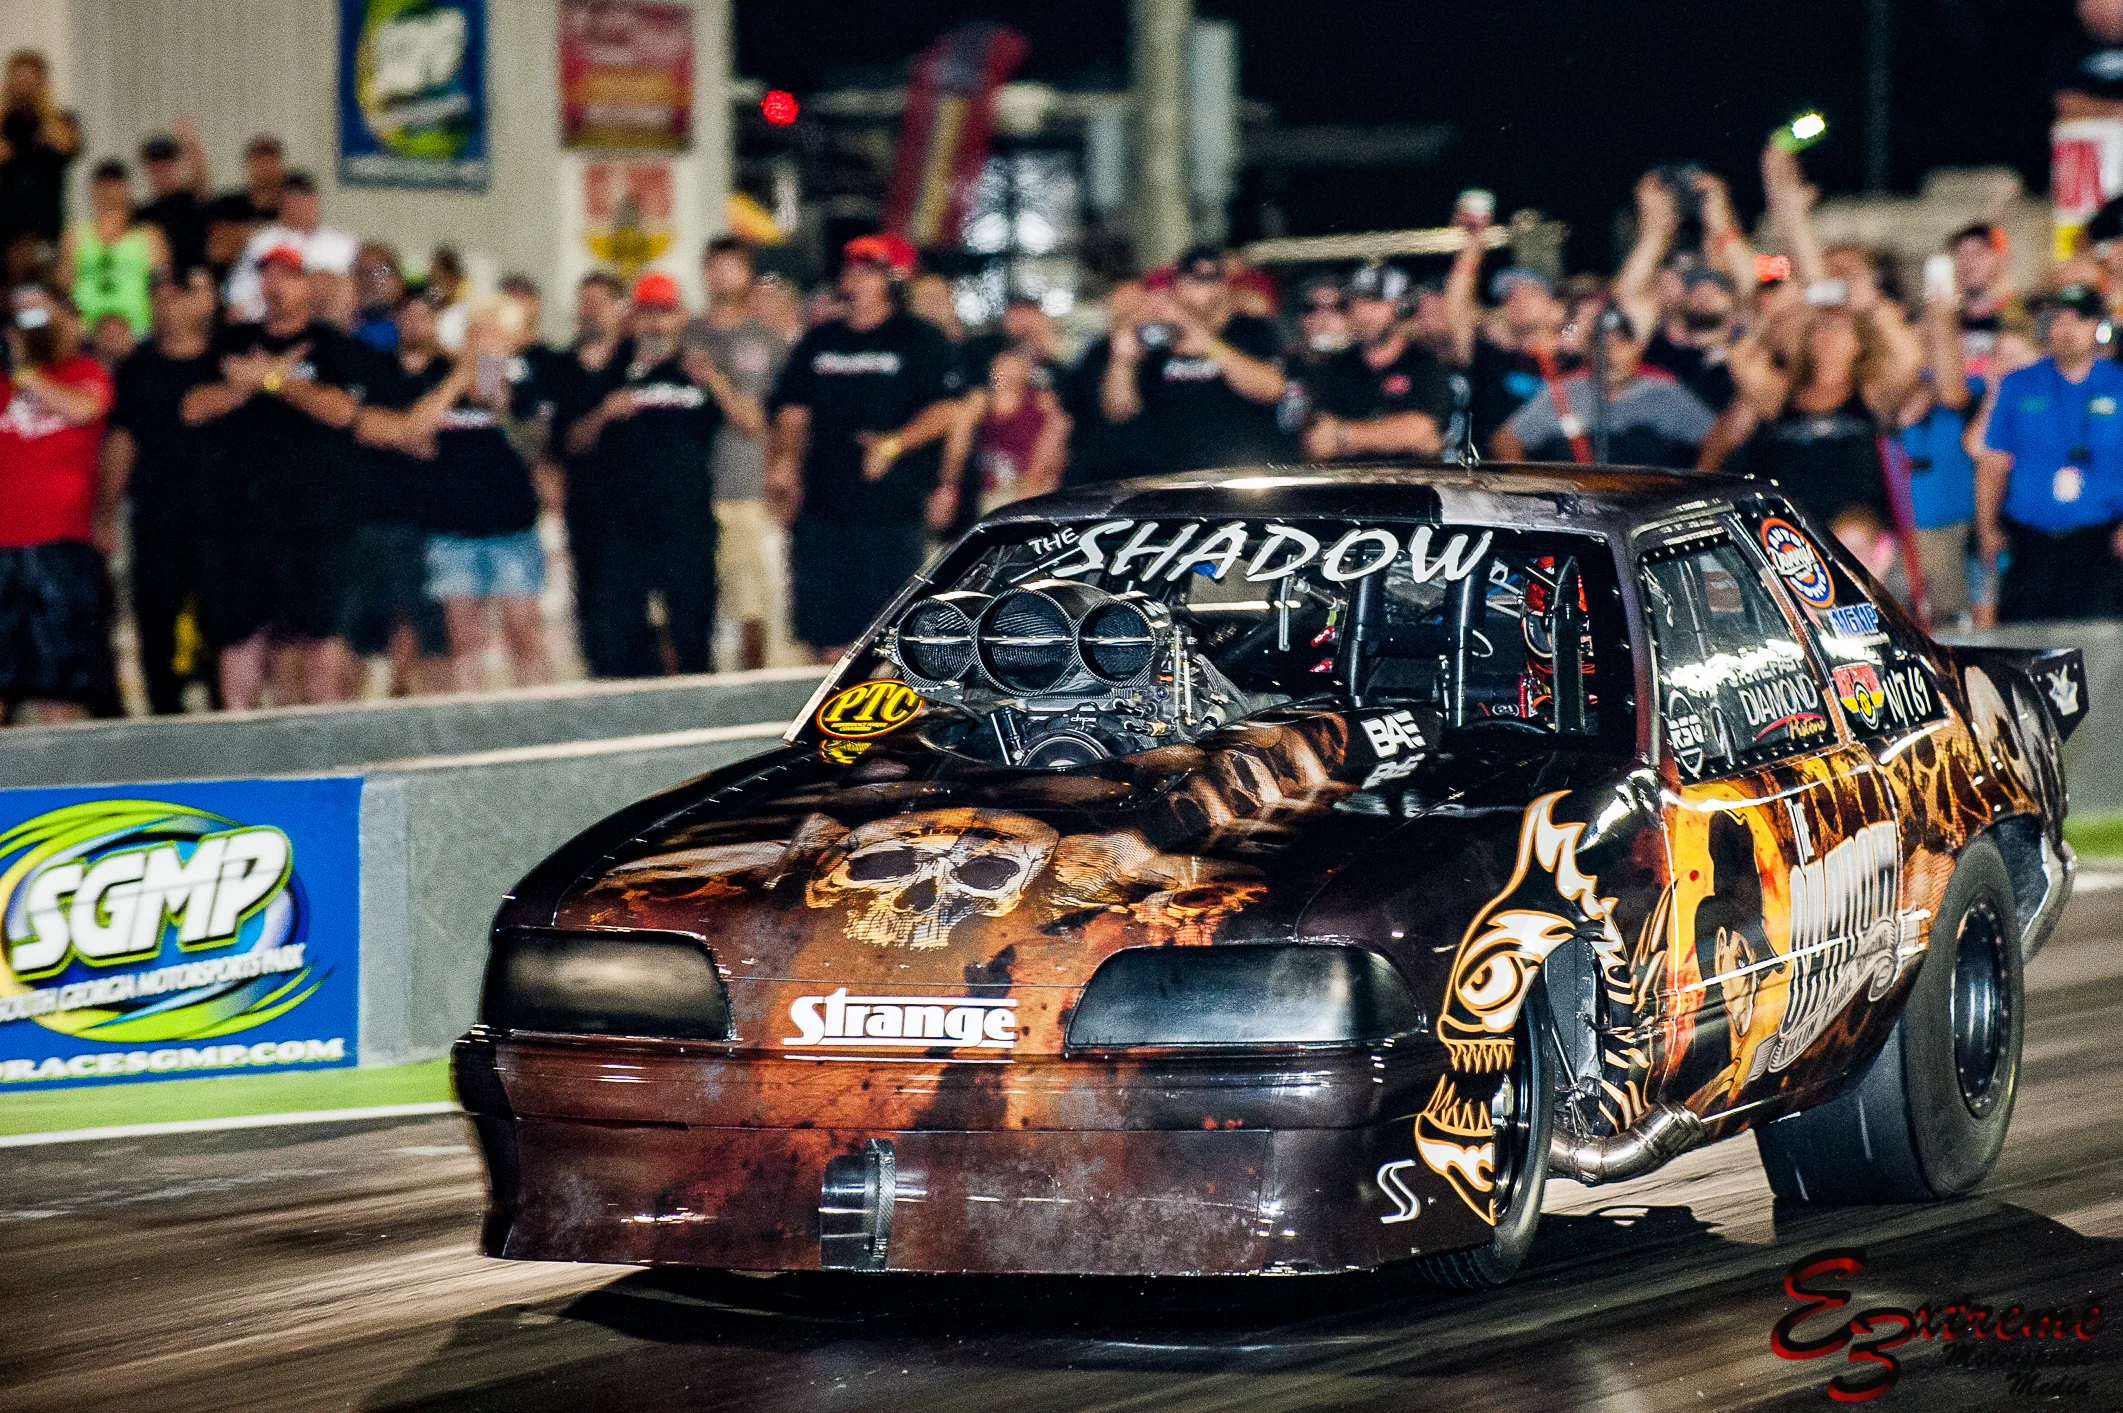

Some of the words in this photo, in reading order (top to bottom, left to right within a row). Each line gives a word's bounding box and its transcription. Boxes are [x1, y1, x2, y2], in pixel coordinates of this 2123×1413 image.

[1028, 527, 1080, 555] THE
[1051, 518, 1494, 583] SHADOW
[824, 683, 918, 722] PTC
[1738, 674, 1819, 726] DIAMOND
[1360, 709, 1427, 759] BAE
[11, 830, 290, 973] SGMP
[784, 987, 1017, 1048] Strange
